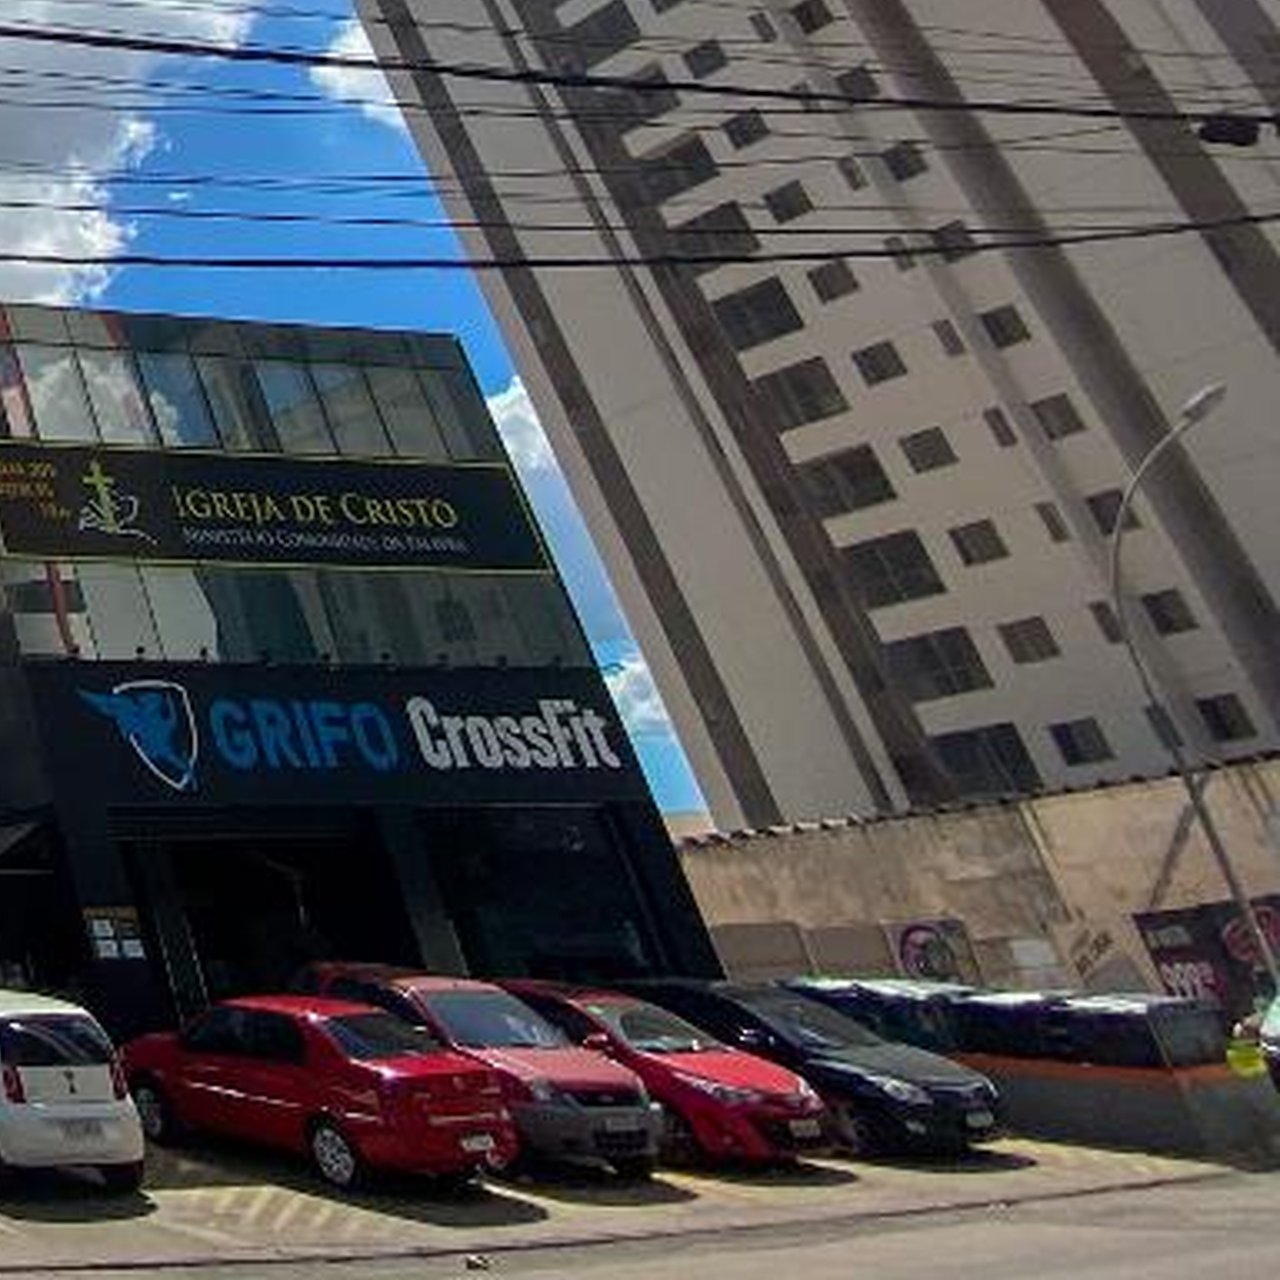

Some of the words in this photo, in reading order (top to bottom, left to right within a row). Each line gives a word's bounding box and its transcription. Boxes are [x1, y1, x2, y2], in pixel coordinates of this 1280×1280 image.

[172, 486, 285, 524] IGREJA
[289, 495, 335, 524] DE
[339, 493, 459, 527] CRISTO
[209, 696, 400, 771] GRIFO
[406, 695, 620, 770] CrossFit
